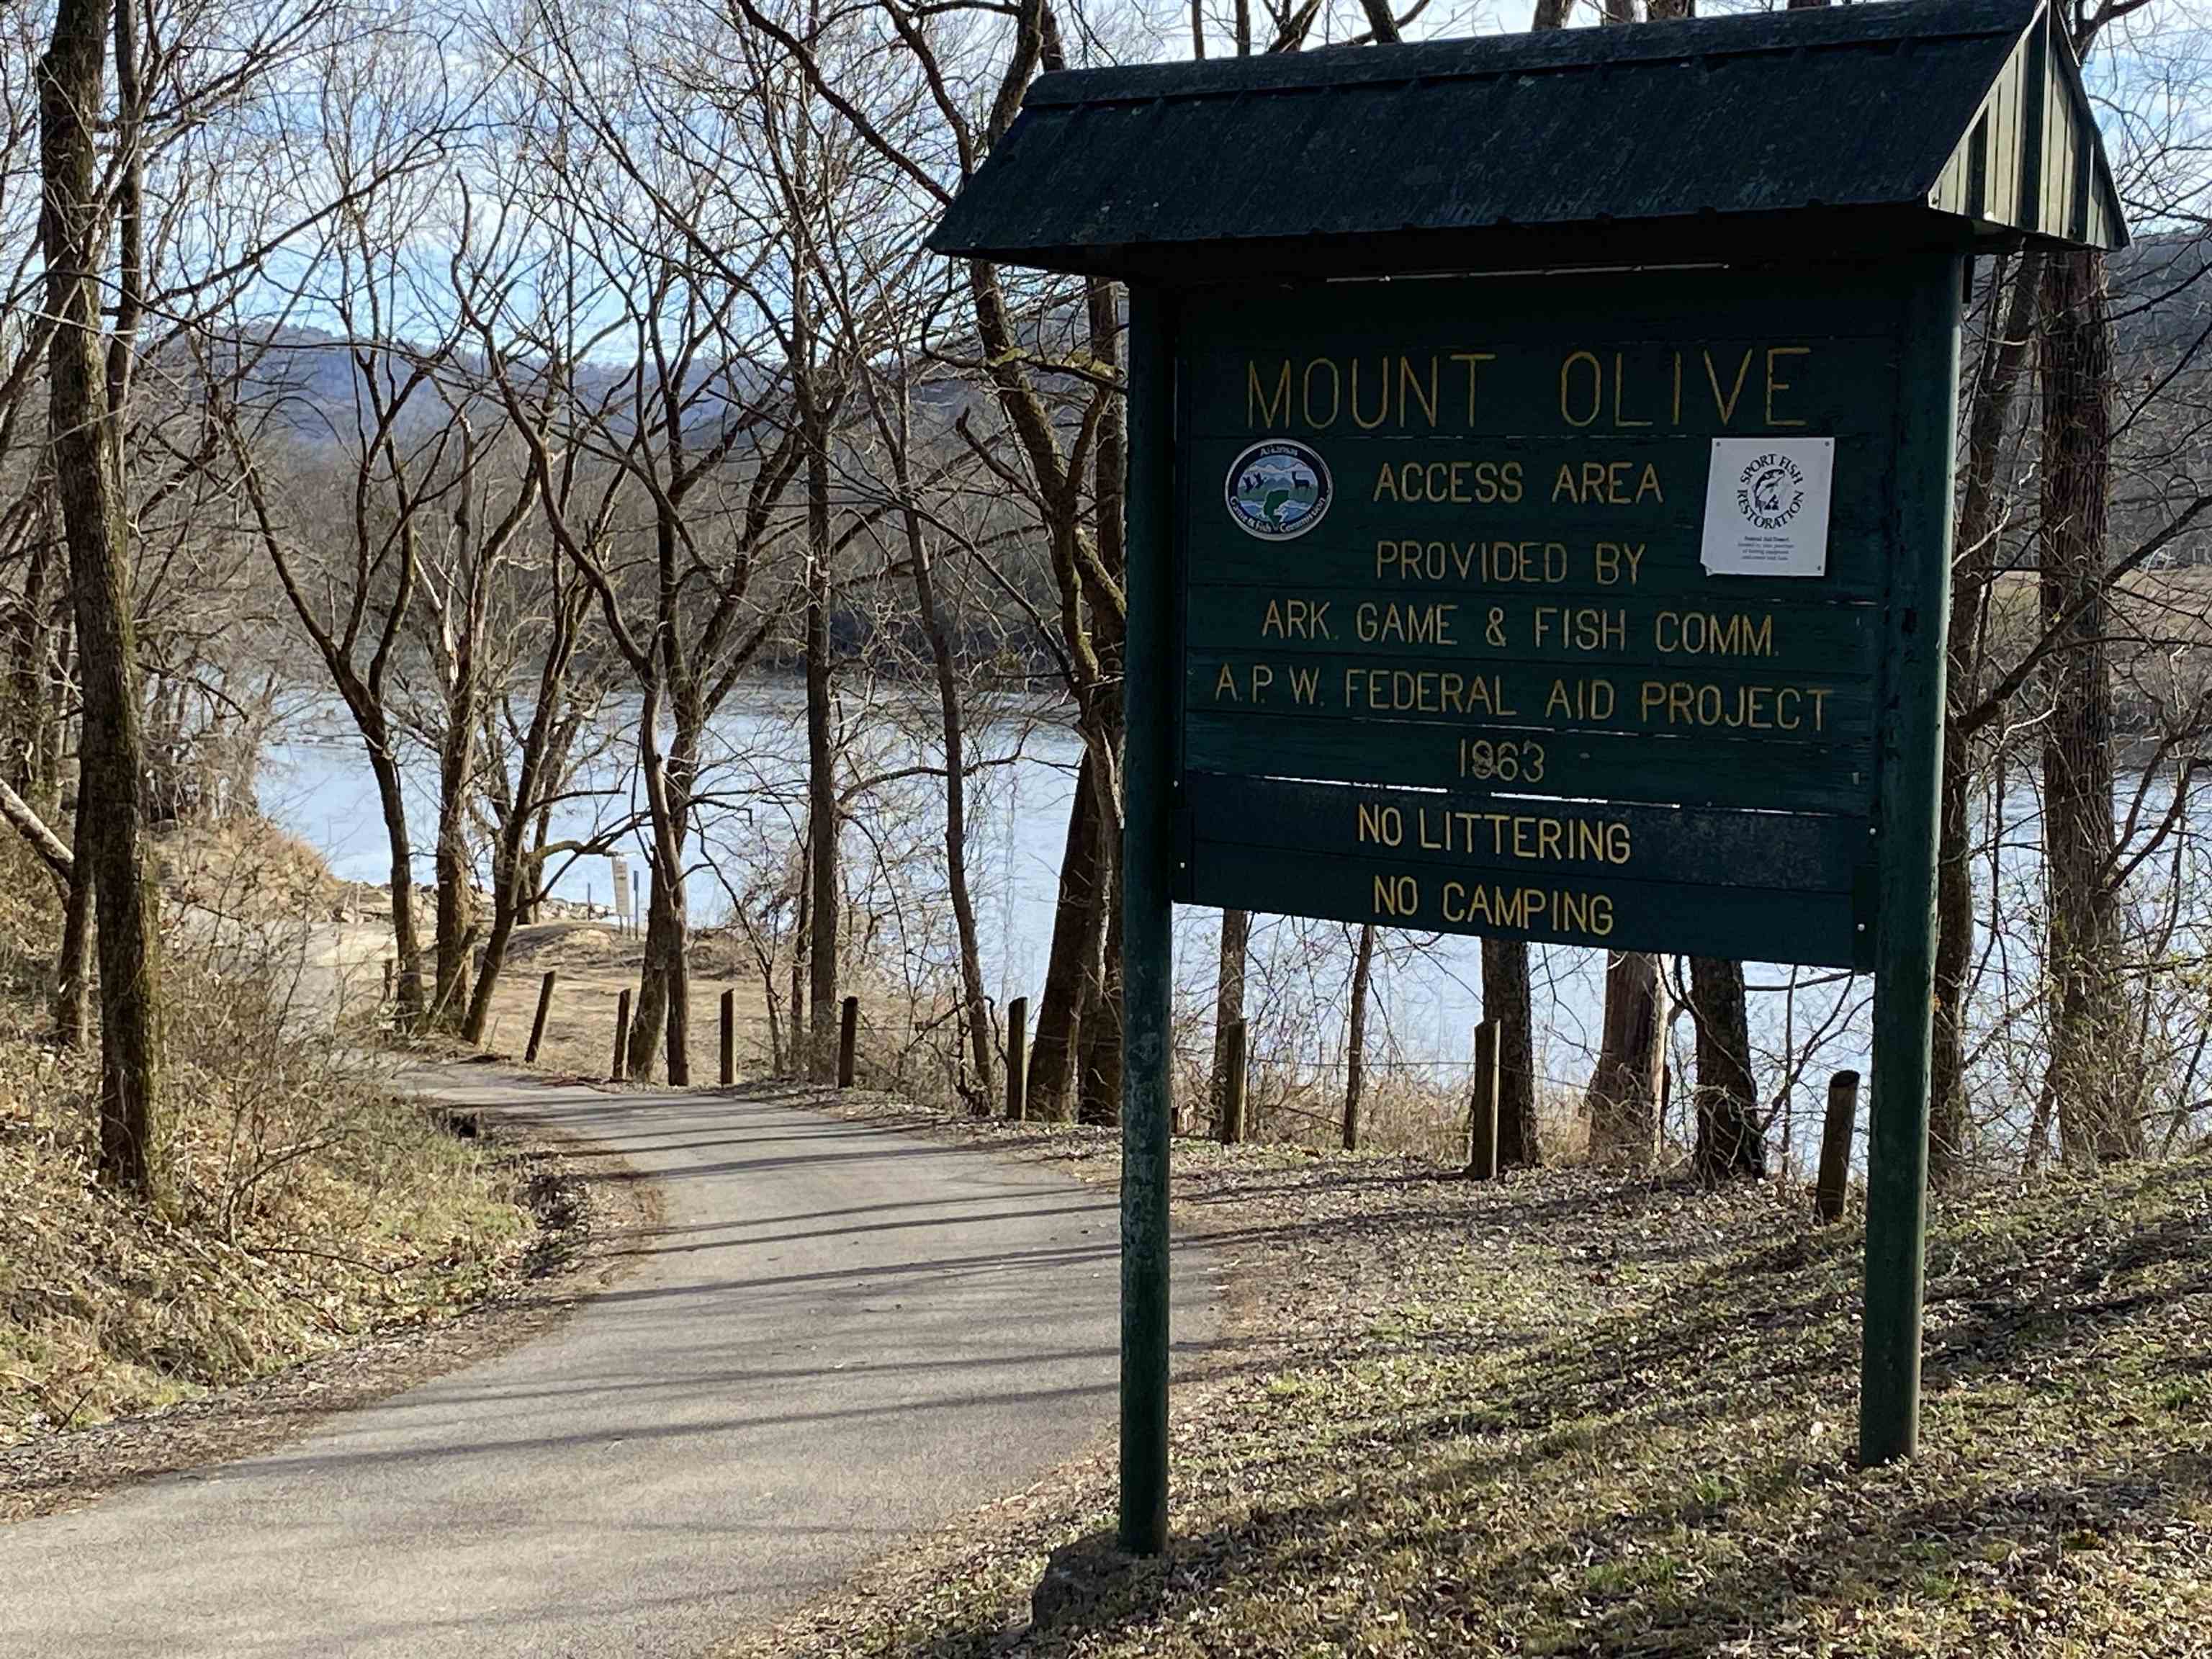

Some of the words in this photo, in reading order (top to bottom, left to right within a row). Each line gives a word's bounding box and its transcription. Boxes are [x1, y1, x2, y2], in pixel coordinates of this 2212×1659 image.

[1249, 354, 1496, 429] MOUNT
[1561, 347, 1810, 427] OLIVE
[1373, 462, 1523, 503] ACCESS
[1552, 462, 1663, 504] AREA
[1740, 453, 1777, 485] SPORT
[1779, 456, 1804, 485] FISH
[1737, 489, 1805, 529] RESTORATION
[1377, 540, 1568, 583] PROVIDED
[1596, 543, 1645, 585] BY
[1262, 598, 1339, 641] ARK.
[1357, 602, 1458, 645] GAME
[1485, 606, 1507, 647] &
[1535, 607, 1625, 651] FISH
[1655, 611, 1779, 657] COMM.
[1346, 668, 1517, 716] FEDERAL
[1545, 679, 1614, 721] AID
[1641, 681, 1833, 731] PROJECT
[1460, 738, 1545, 783] 1963
[1359, 803, 1403, 847] NO
[1419, 807, 1632, 864] LITTERING
[1374, 875, 1419, 916] NO
[1442, 882, 1614, 936] CAMPING
